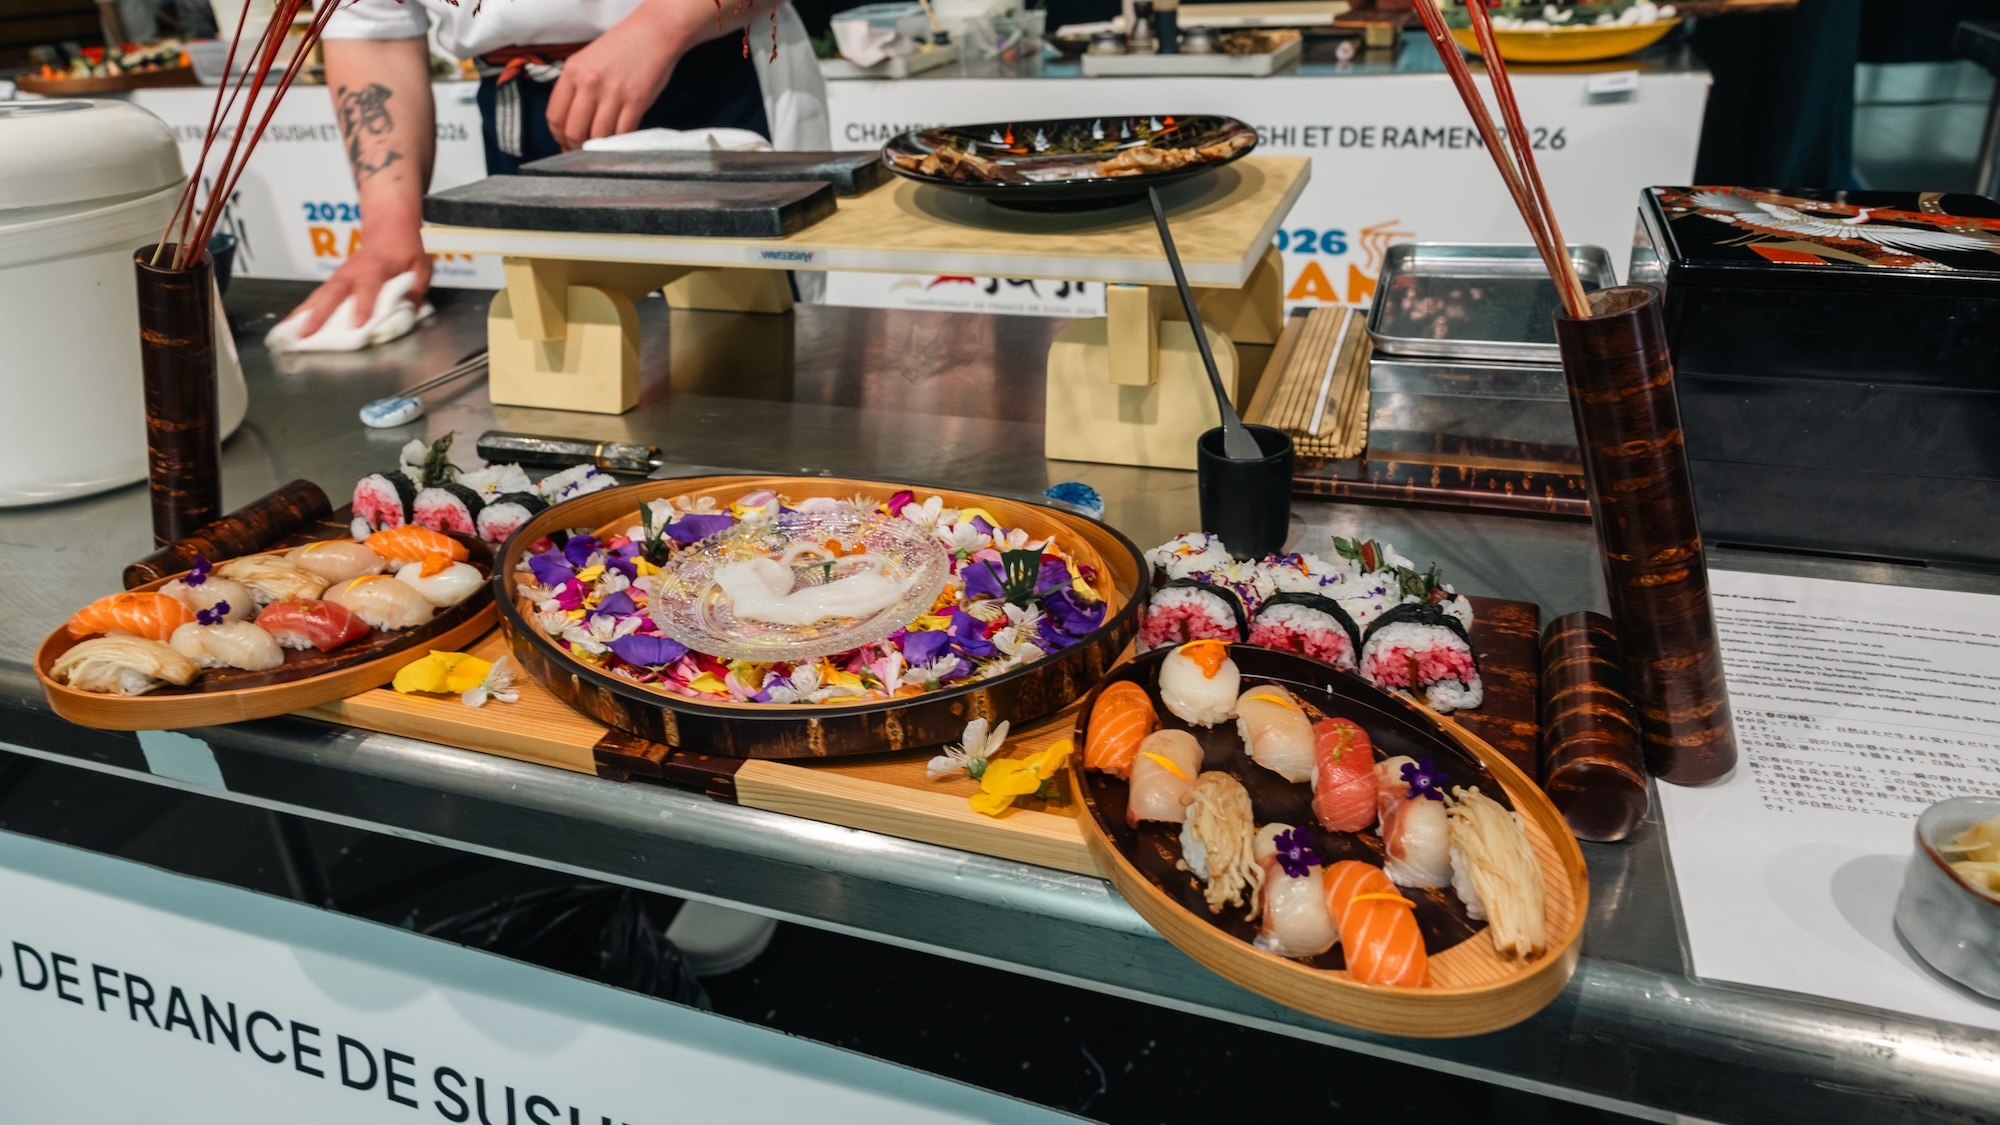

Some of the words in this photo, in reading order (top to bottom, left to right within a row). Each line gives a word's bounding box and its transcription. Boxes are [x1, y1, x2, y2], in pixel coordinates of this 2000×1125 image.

[272, 122, 318, 144] SUSHI
[436, 124, 469, 146] 026
[1304, 126, 1332, 148] ET
[1340, 126, 1376, 148] DE
[1382, 127, 1483, 149] RAMEN
[1498, 127, 1566, 150] 26
[1277, 228, 1348, 255] 026
[12, 940, 84, 1006] DE
[91, 962, 325, 1080] FRANCE
[337, 1033, 419, 1110] DE
[433, 1066, 635, 1125] SUS
